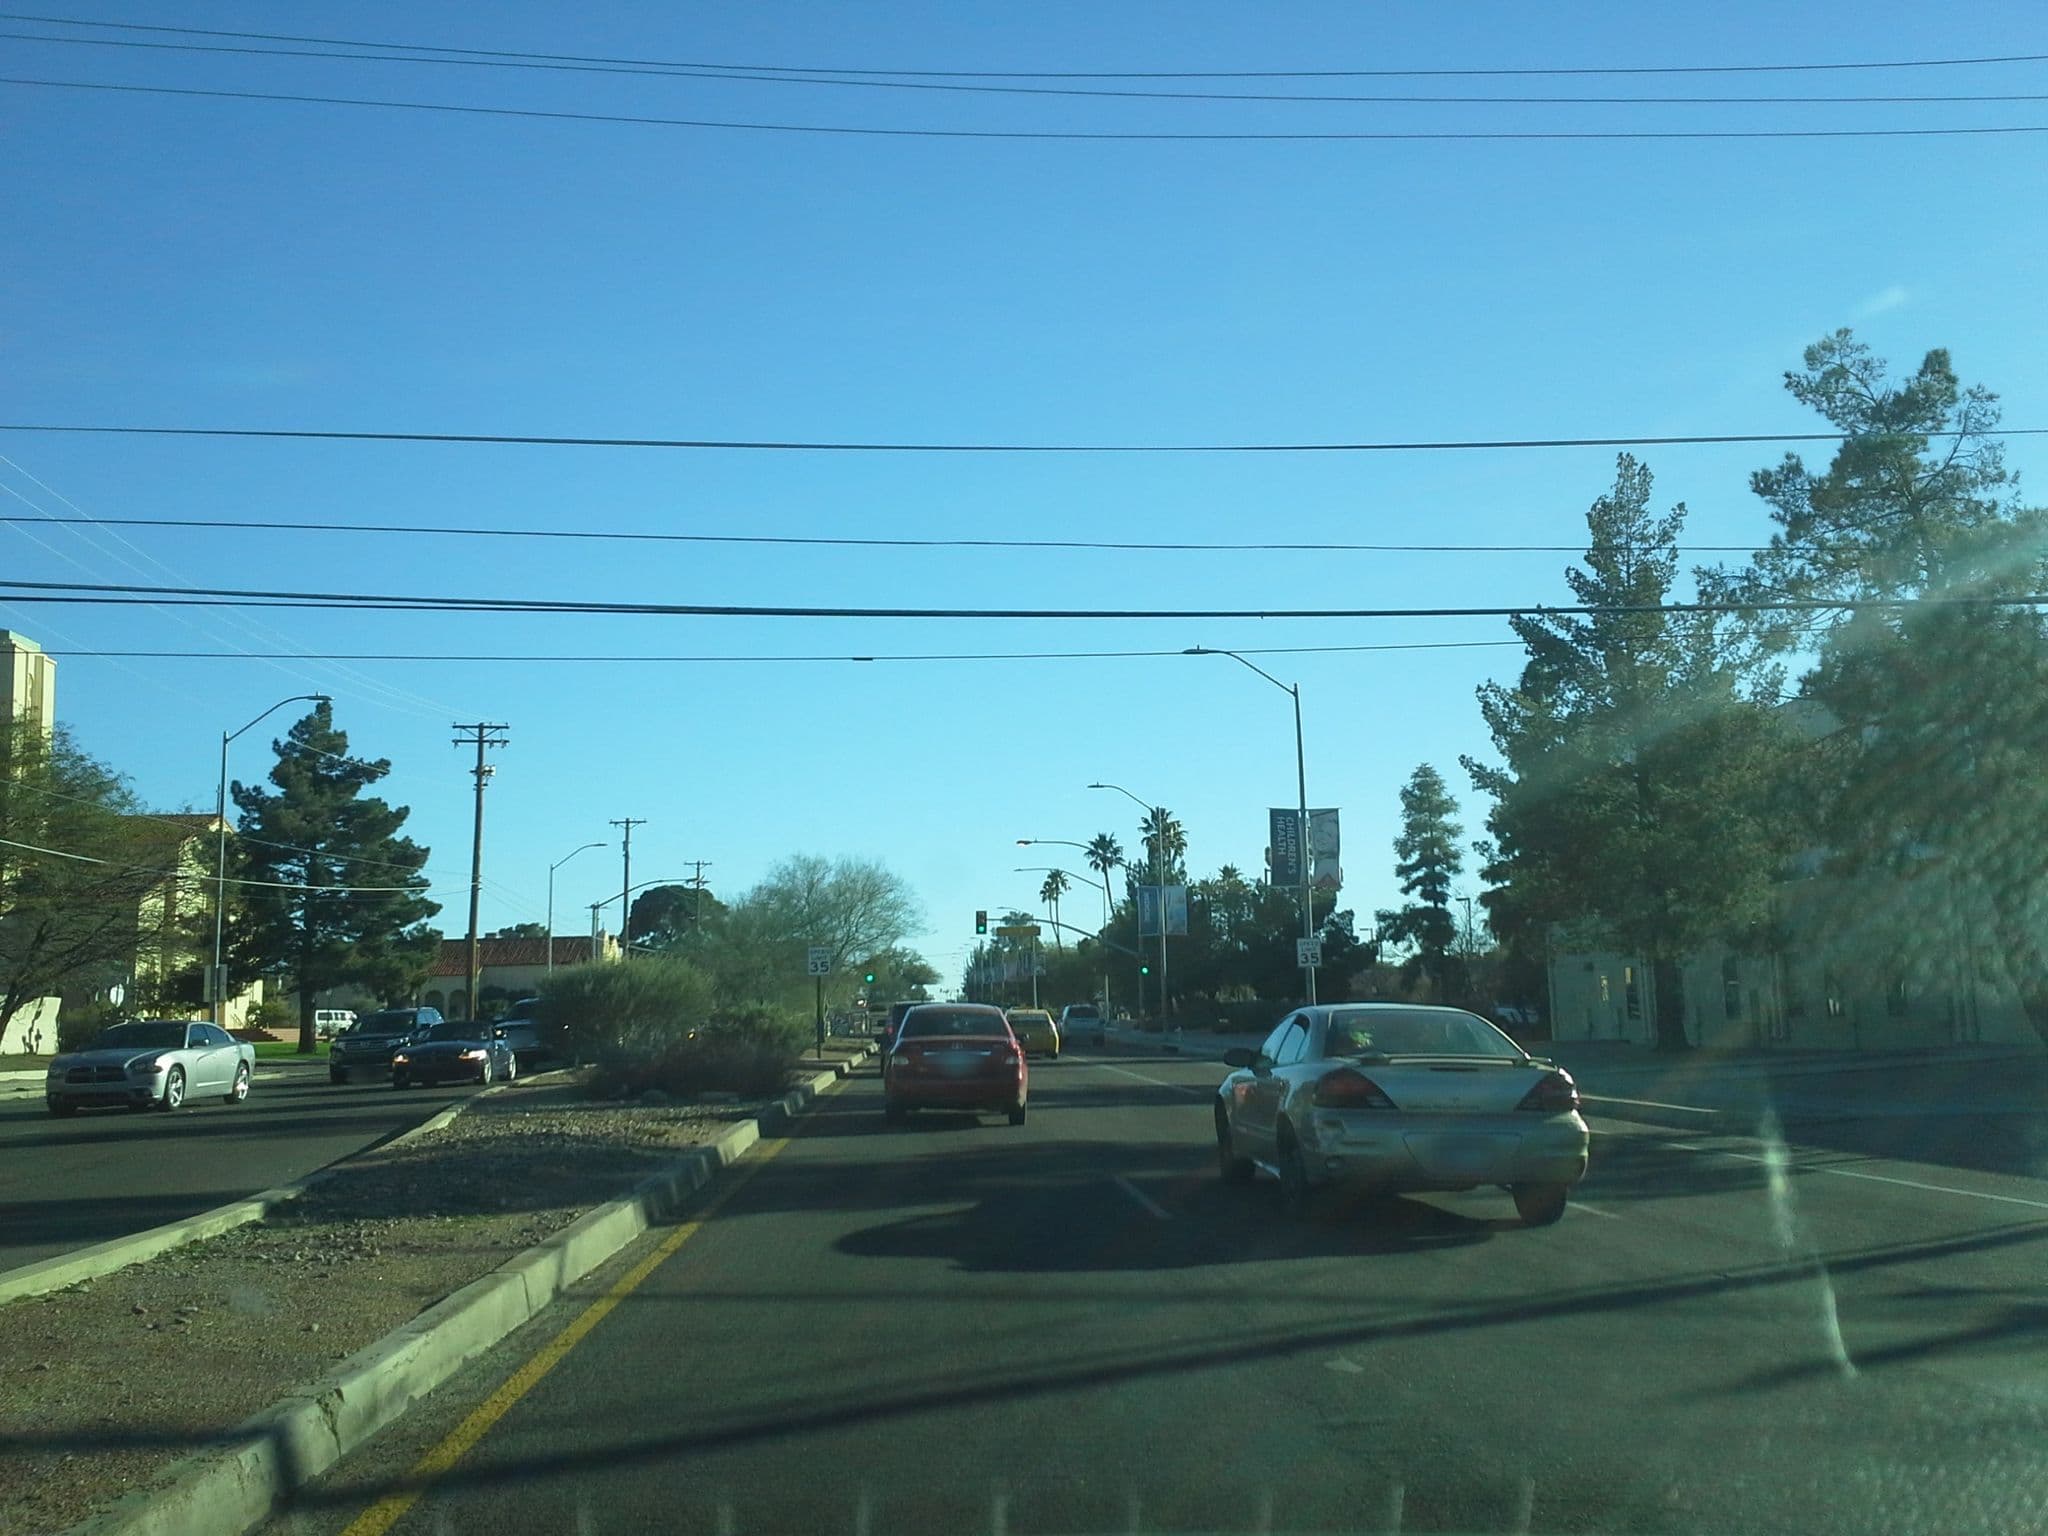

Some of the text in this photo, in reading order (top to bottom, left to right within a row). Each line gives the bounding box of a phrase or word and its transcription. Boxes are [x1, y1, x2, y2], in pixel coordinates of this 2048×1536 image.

[1276, 816, 1287, 856] HEALTH
[1286, 816, 1297, 875] CHILDREN'S
[810, 961, 829, 973] 35
[1300, 952, 1319, 964] 35
